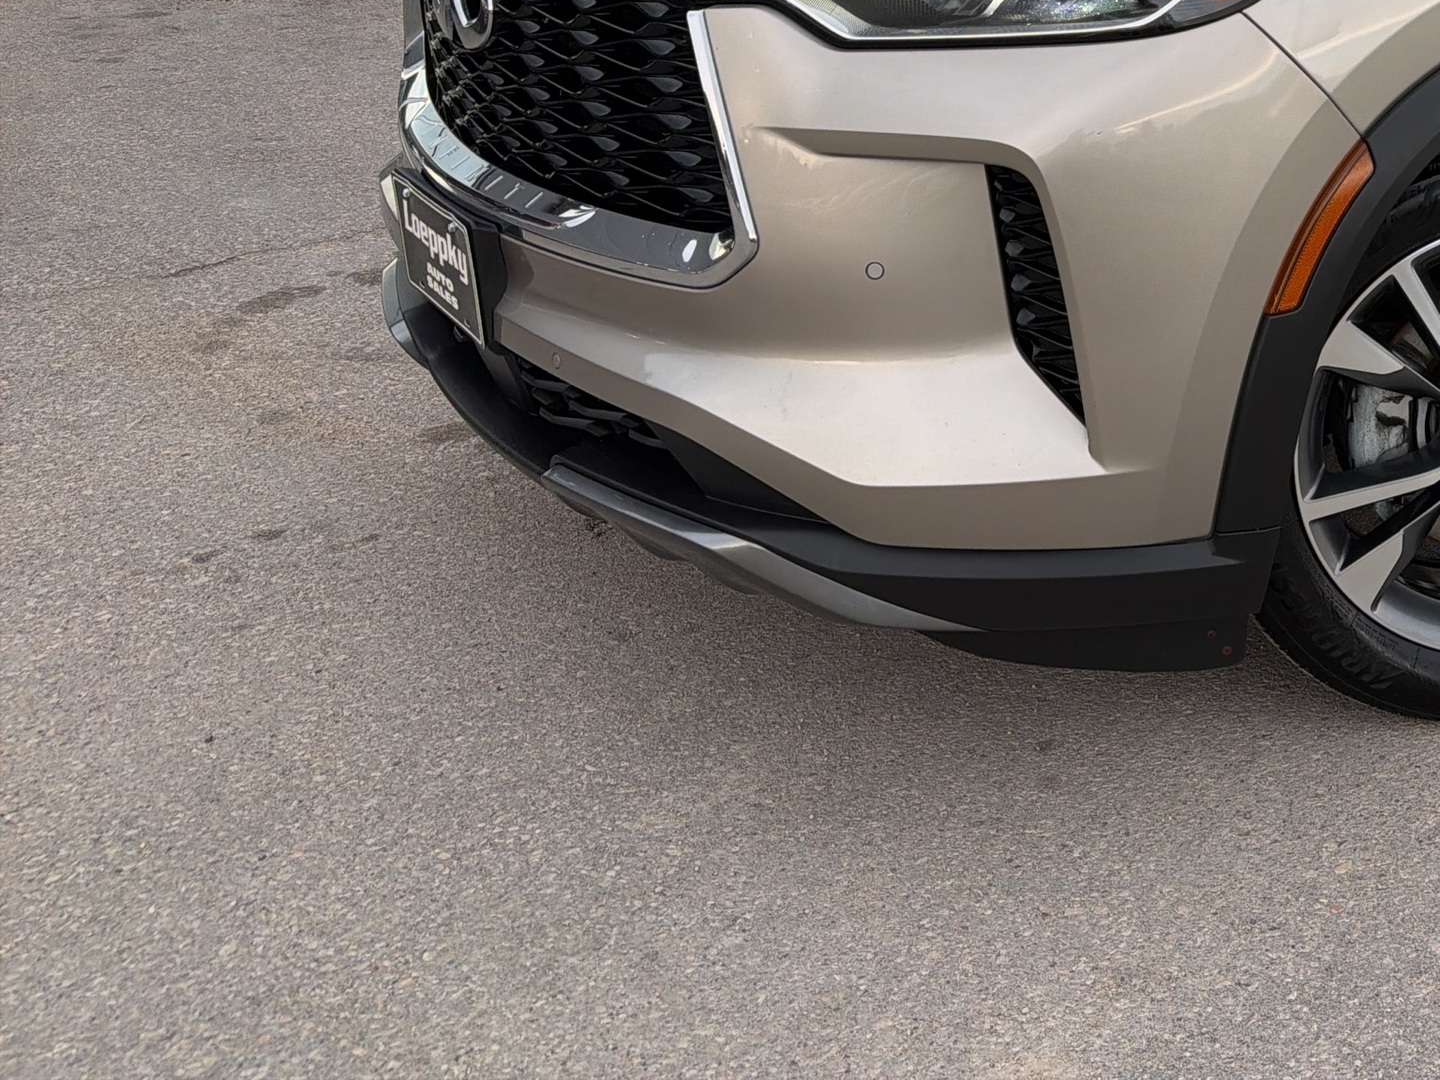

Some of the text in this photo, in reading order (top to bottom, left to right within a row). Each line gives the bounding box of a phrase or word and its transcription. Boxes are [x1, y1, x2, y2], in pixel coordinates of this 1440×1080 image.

[402, 199, 468, 286] Loeppky
[427, 262, 454, 292] AUTO
[427, 275, 459, 310] SALES
